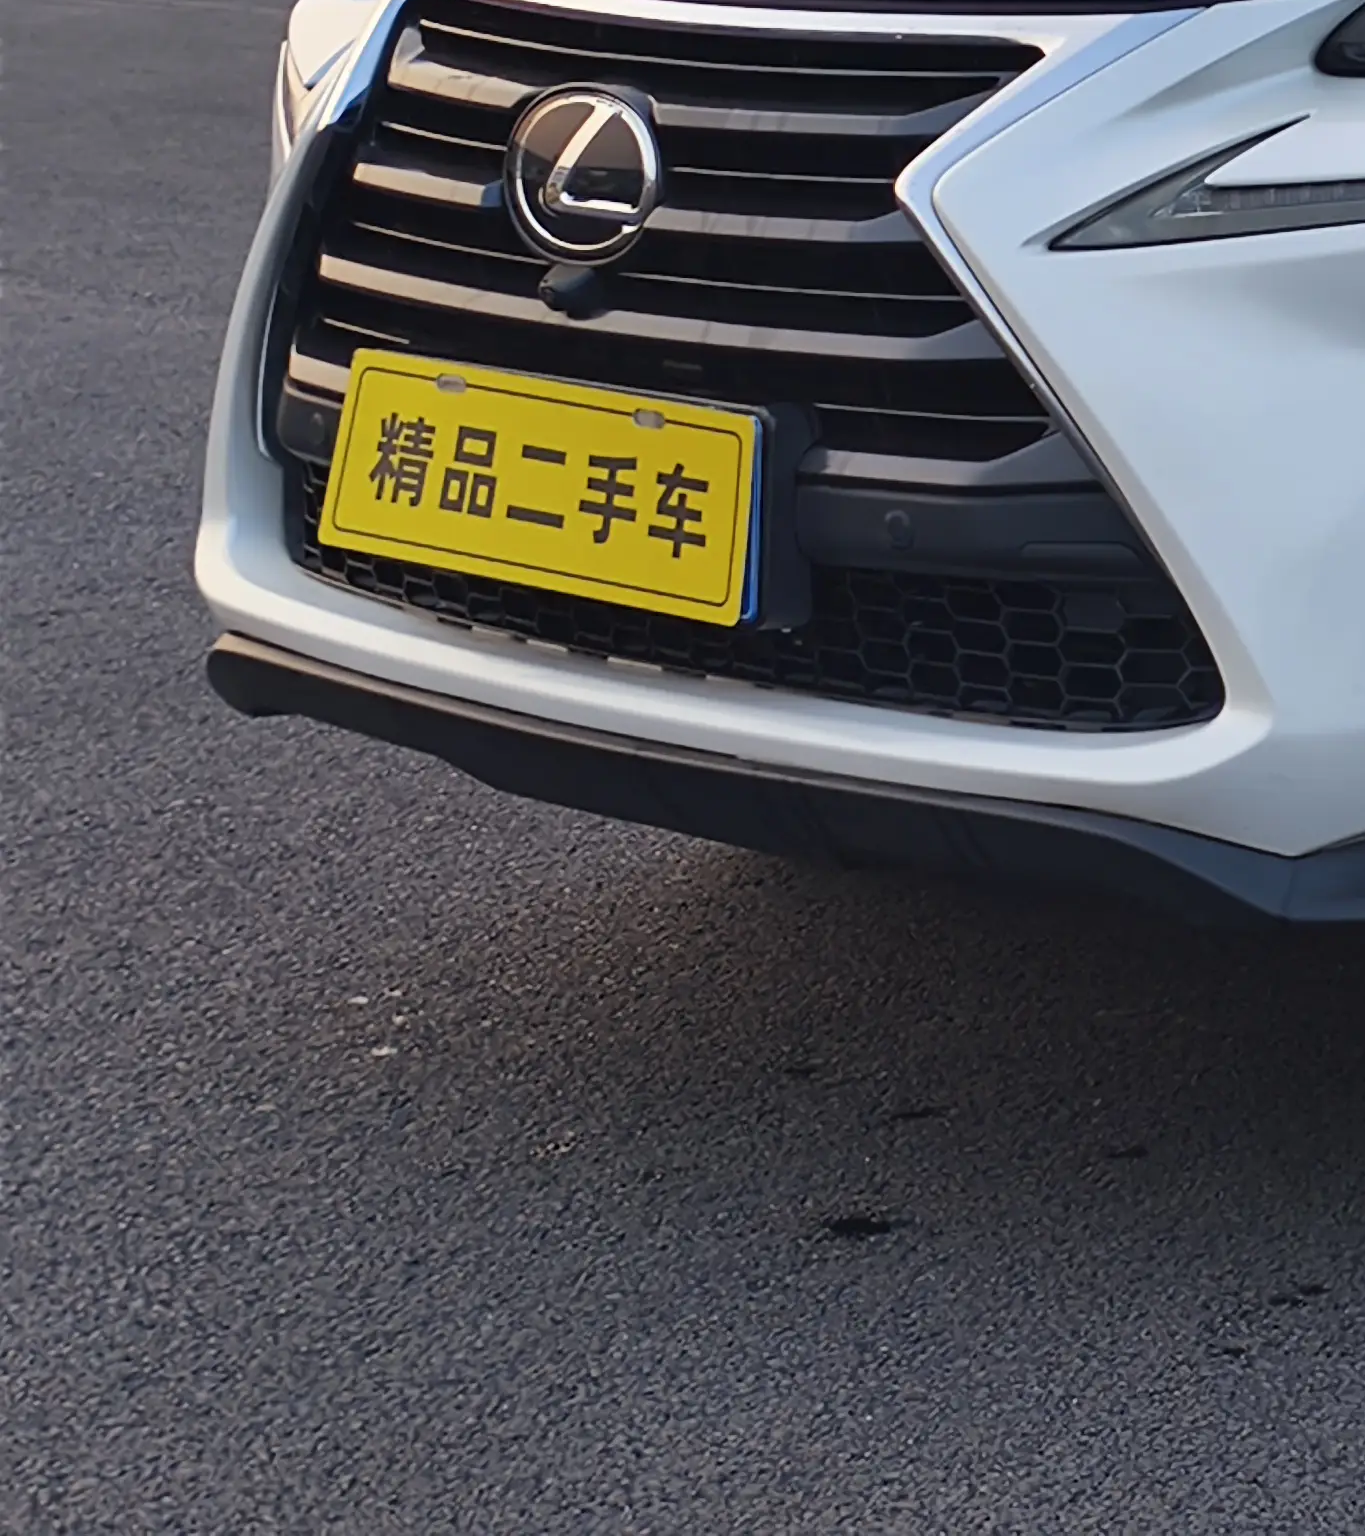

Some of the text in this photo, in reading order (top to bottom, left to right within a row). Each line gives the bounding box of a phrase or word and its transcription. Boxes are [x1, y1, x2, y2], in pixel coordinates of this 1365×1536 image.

[368, 412, 710, 559] 精品二手车
